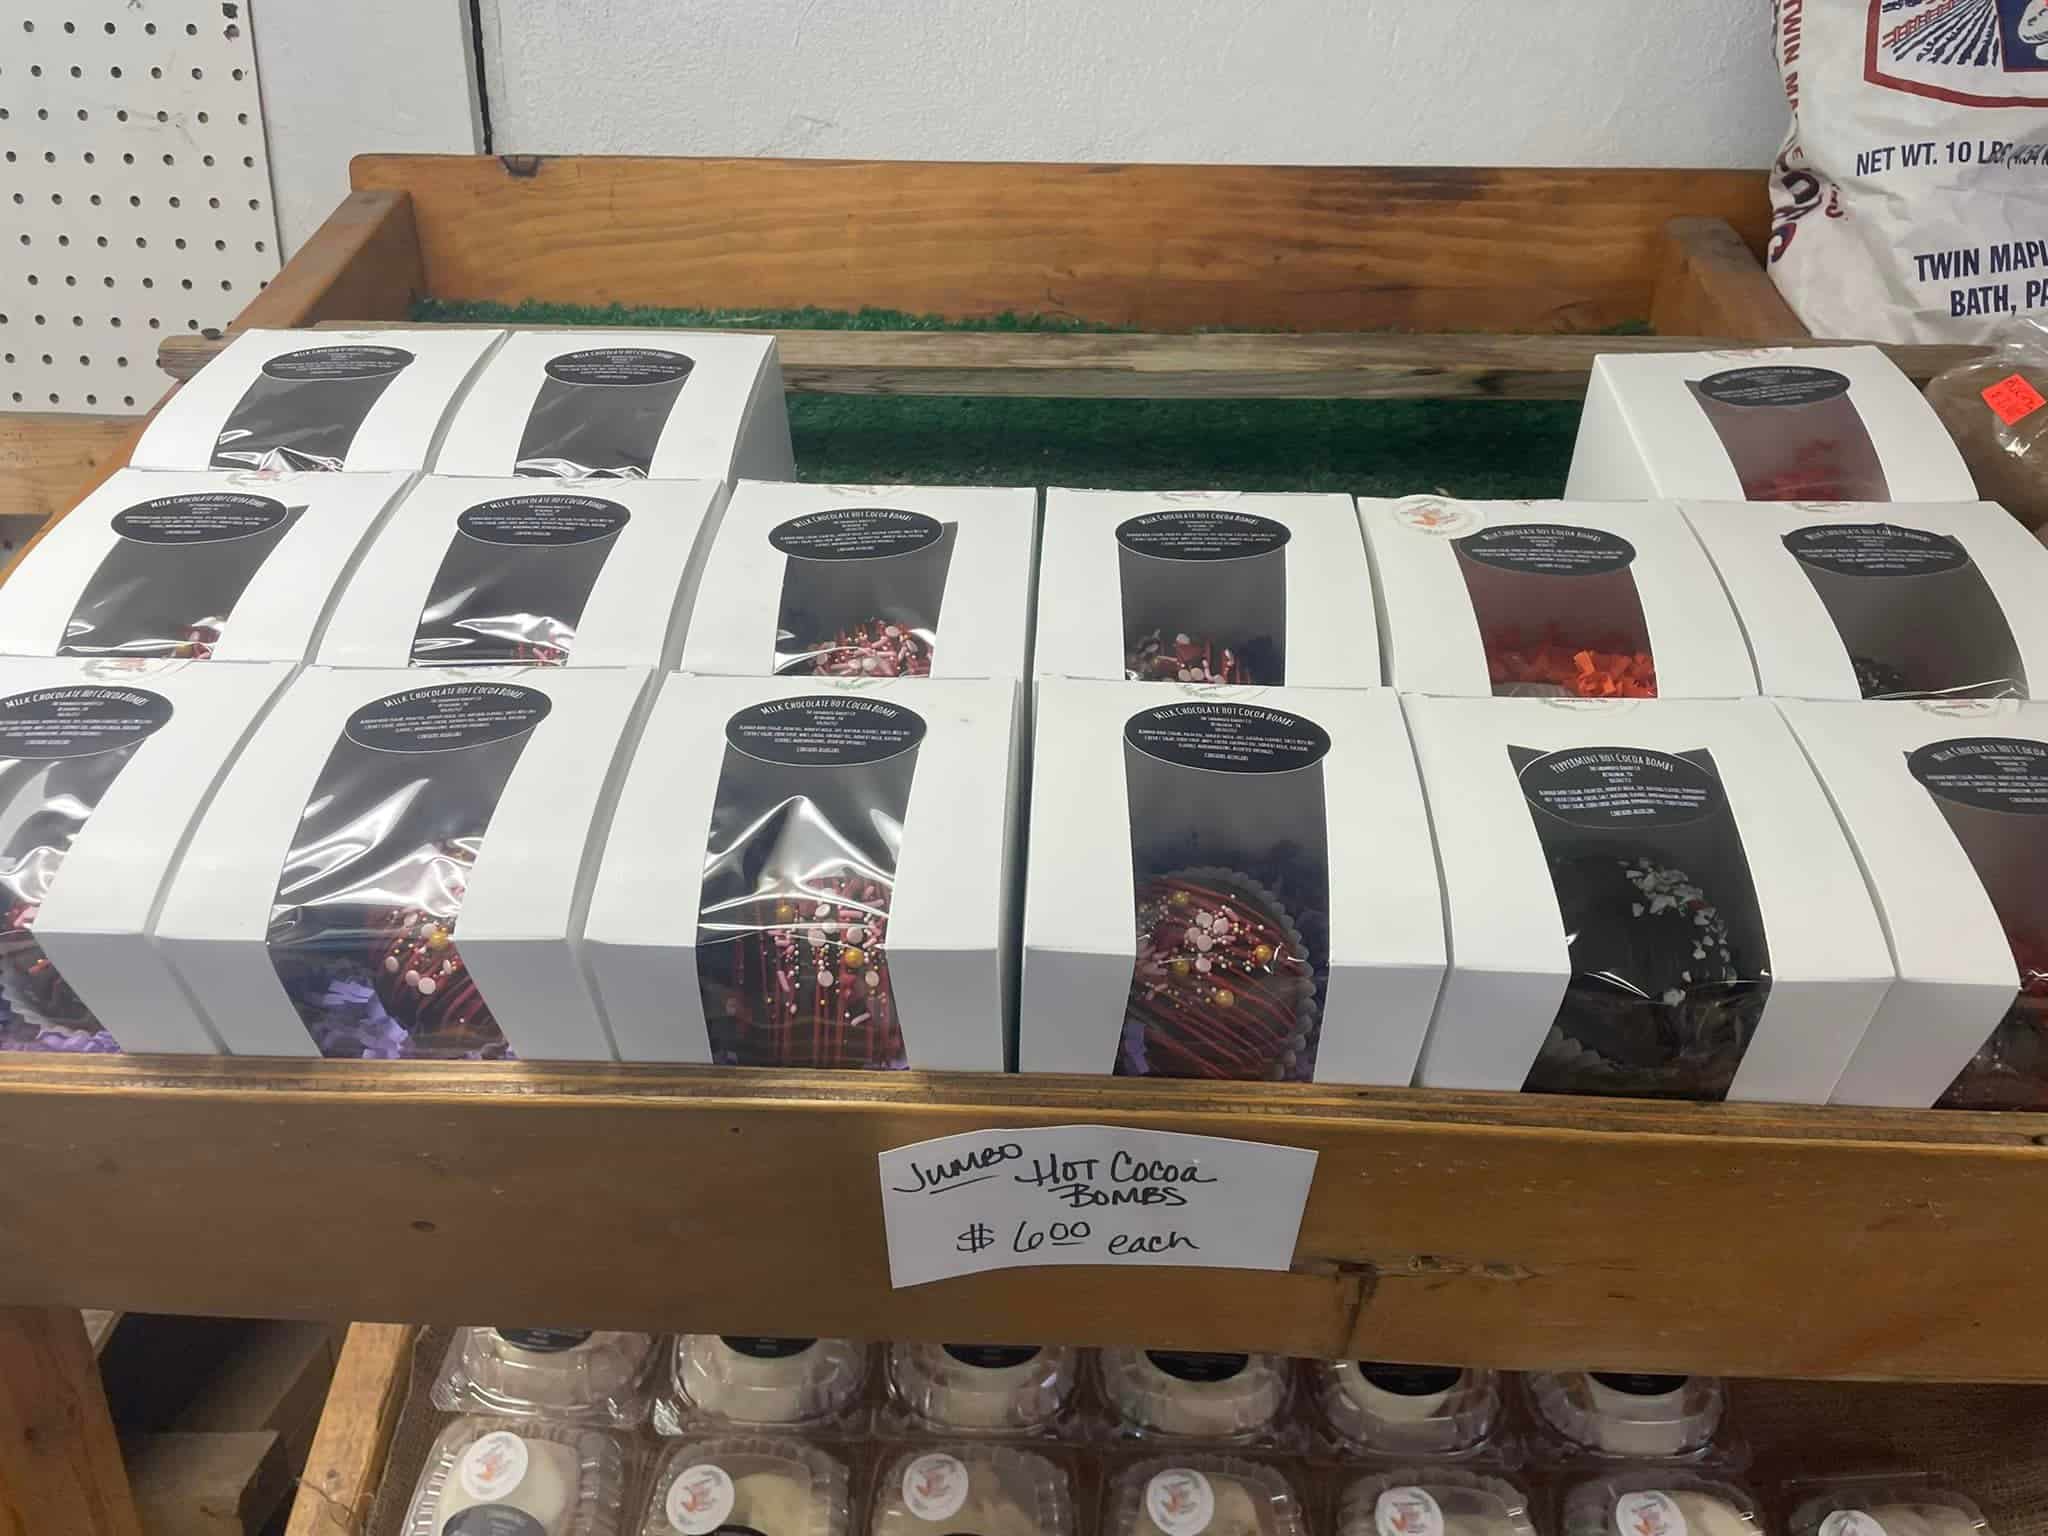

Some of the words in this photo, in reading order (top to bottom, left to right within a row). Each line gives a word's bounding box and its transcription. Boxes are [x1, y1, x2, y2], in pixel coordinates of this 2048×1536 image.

[1857, 147, 1895, 176] NET
[1902, 143, 1937, 167] WT.
[1946, 141, 1971, 164] 10
[1914, 248, 1979, 281] TWIN
[1951, 284, 2016, 317] BATH,
[383, 693, 408, 708] MILK
[409, 688, 455, 702] CHOCOLATE
[760, 704, 783, 715] MILK
[785, 699, 829, 710] CHOCOLATE
[831, 699, 845, 708] HOT
[846, 700, 871, 710] COCOA
[1153, 711, 1175, 720] MILK
[1176, 706, 1220, 717] CHOCOLATE
[1222, 707, 1236, 715] HOT
[1238, 707, 1265, 719] COCOA
[1549, 754, 1598, 774] PEPPERMINT
[1599, 754, 1615, 762] HOT
[1616, 753, 1644, 765] COCOA
[1646, 757, 1674, 772] BOMBS
[1014, 1153, 1099, 1191] HOT
[1048, 1183, 1188, 1207] BOMBS
[1108, 1231, 1200, 1255] each
